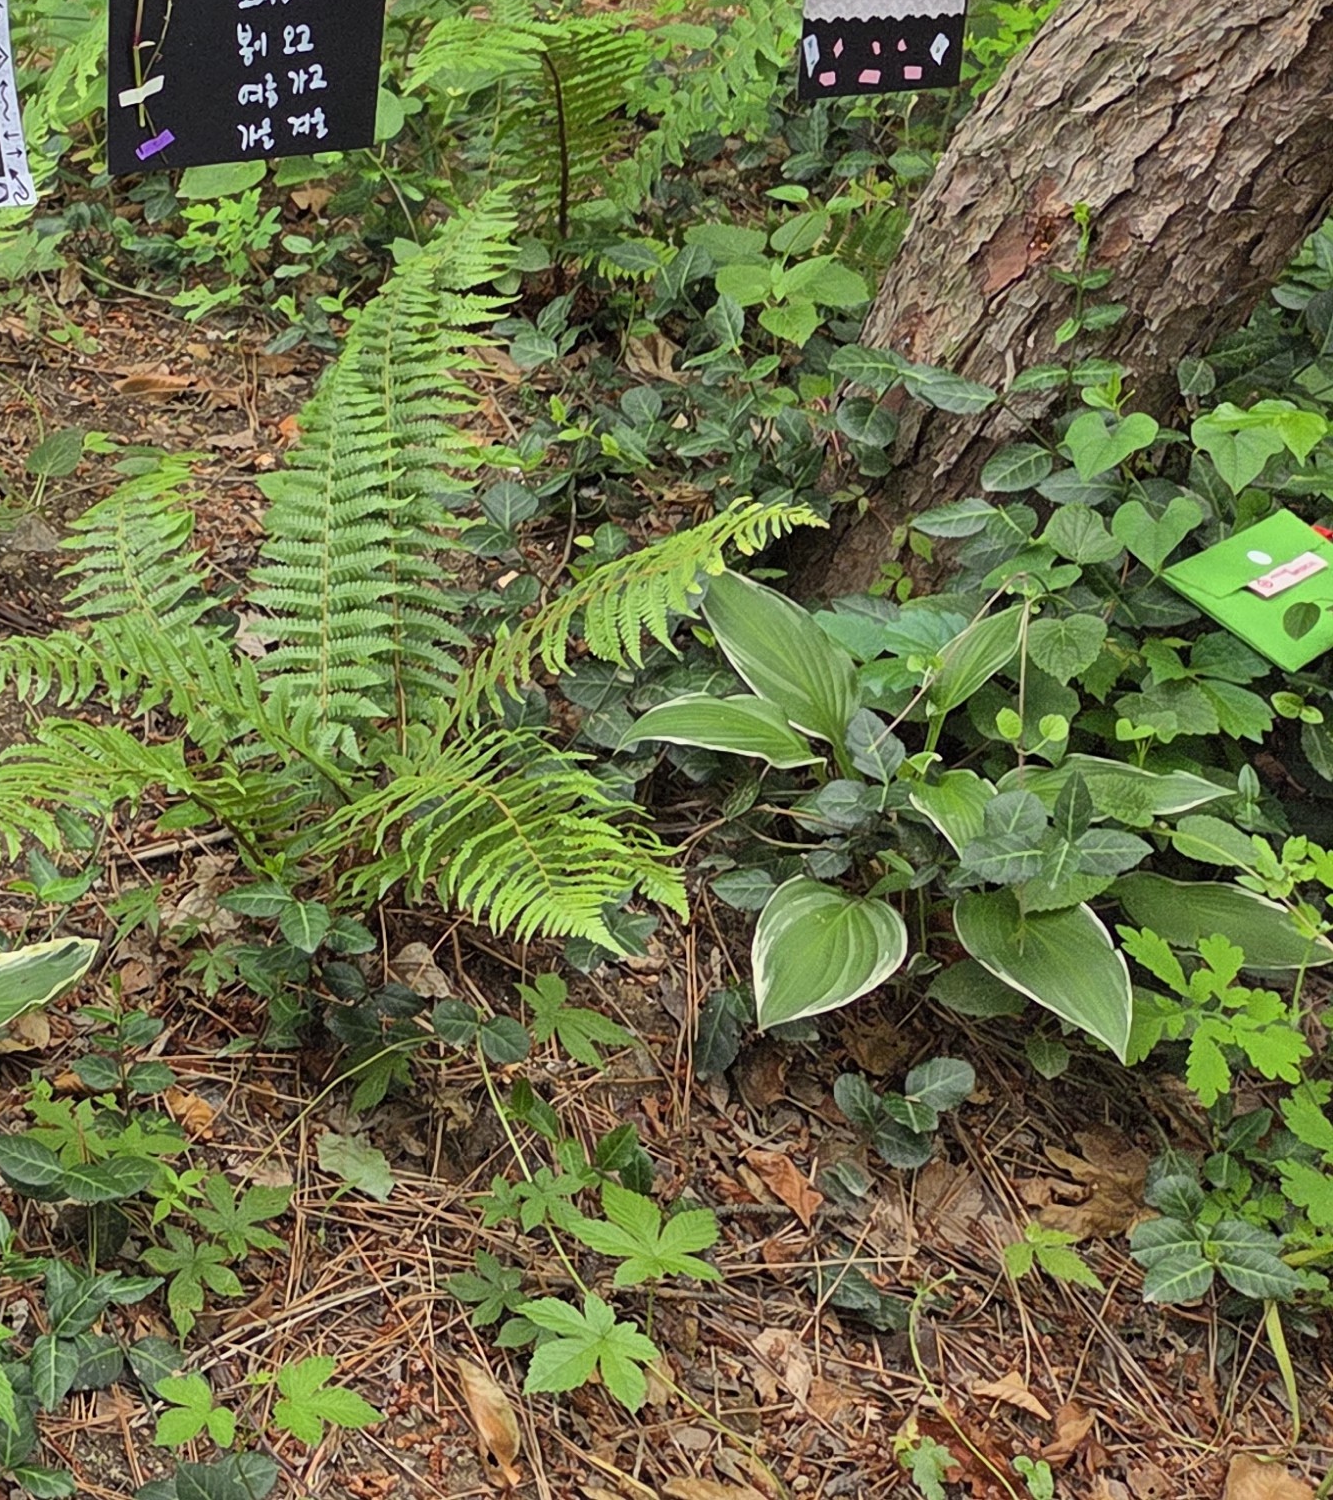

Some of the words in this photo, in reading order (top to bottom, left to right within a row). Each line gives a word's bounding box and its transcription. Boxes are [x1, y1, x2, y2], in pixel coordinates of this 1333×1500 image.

[236, 23, 267, 67] 봄이
[282, 24, 314, 55] 오고
[237, 72, 279, 109] 여름
[287, 63, 328, 95] 가고
[236, 117, 275, 151] 가을
[286, 106, 329, 139] 겨울
